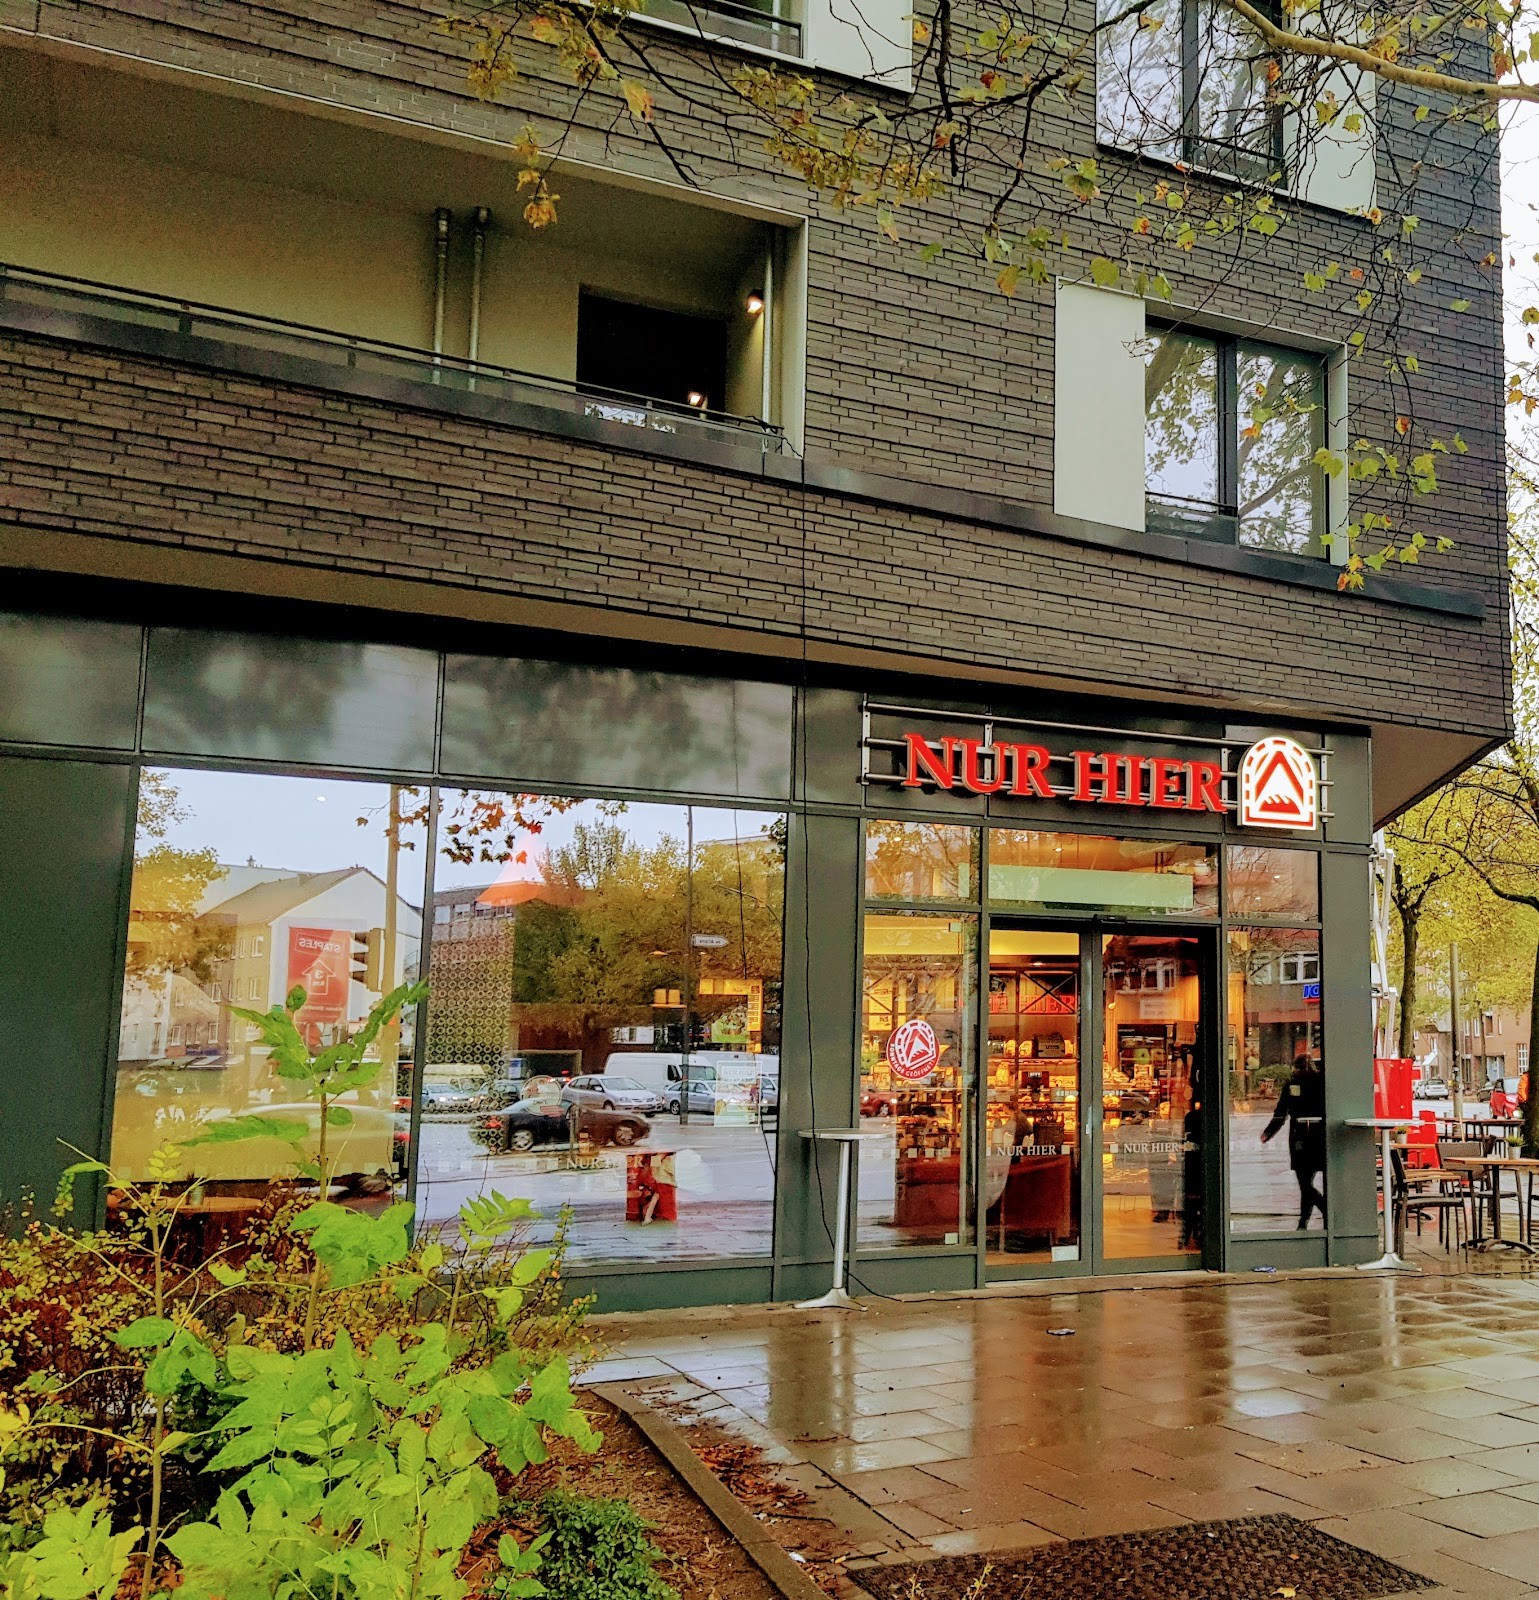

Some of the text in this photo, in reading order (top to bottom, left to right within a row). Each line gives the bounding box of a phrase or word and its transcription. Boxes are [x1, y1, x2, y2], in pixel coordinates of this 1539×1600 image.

[903, 733, 1228, 813] NUR HIER
[997, 1145, 1057, 1157] NUR HIER
[1123, 1142, 1179, 1154] NUR HIER
[566, 1156, 600, 1170] NUR
